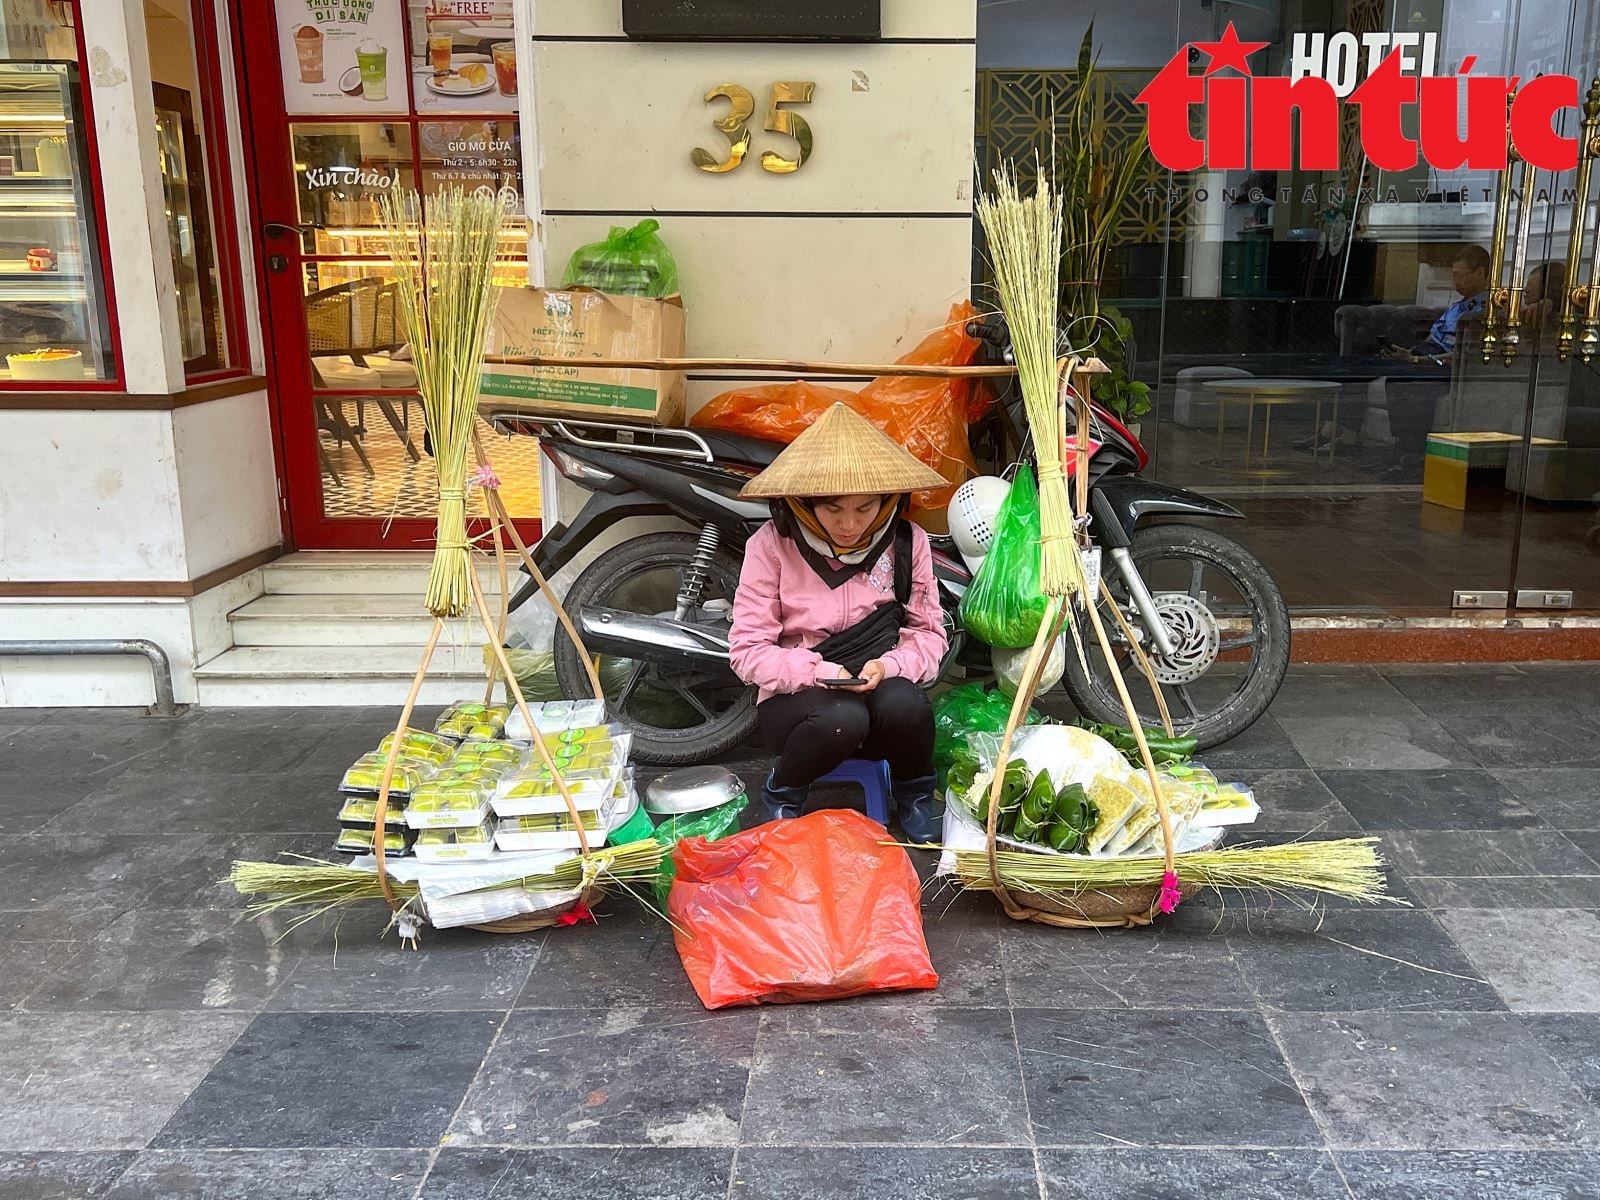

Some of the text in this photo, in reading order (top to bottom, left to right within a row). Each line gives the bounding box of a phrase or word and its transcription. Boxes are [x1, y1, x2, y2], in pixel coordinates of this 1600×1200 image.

[315, 9, 331, 21] DI
[690, 81, 816, 174] 35
[448, 137, 512, 152] GIỜ MỞ CỬA
[442, 157, 458, 166] Thứ
[457, 158, 464, 166] 2
[503, 158, 518, 166] 22h
[305, 167, 398, 190] Xin chào!
[431, 172, 447, 180] Thứ
[460, 172, 467, 180] &
[467, 171, 481, 180] chủ
